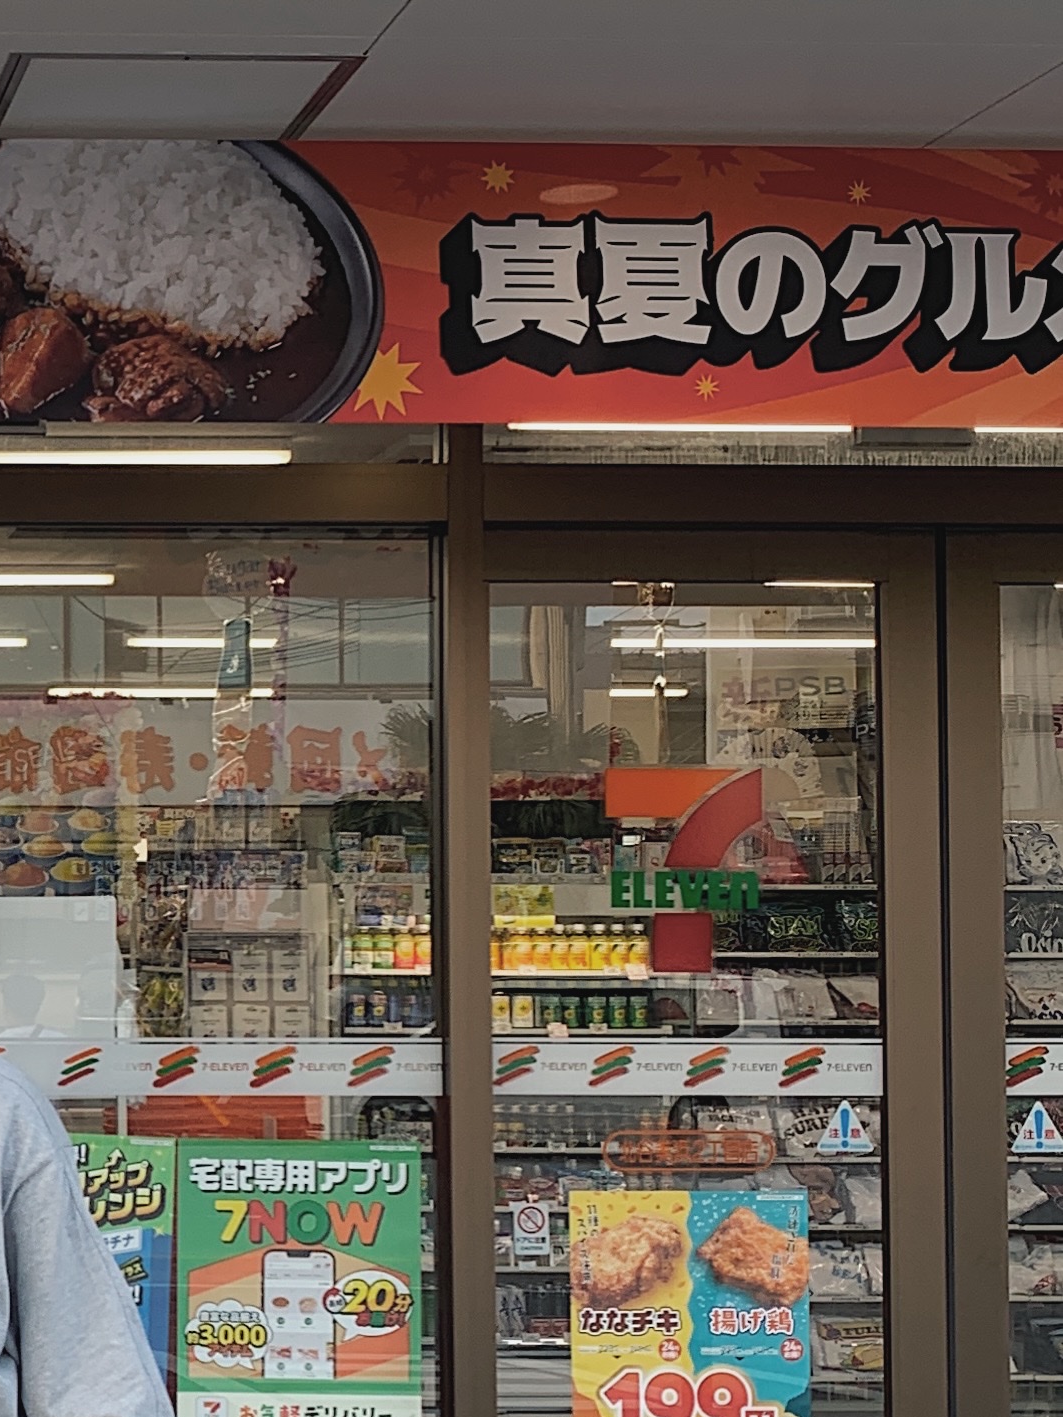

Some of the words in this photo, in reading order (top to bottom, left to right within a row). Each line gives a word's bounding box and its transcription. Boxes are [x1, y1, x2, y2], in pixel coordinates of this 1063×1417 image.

[768, 915, 823, 938] SPAM
[189, 1157, 409, 1193] 宅配専用アプリ
[214, 1199, 385, 1246] 7NOW
[581, 1309, 681, 1335] ななチキ
[710, 1307, 793, 1335] 揚げ鶏
